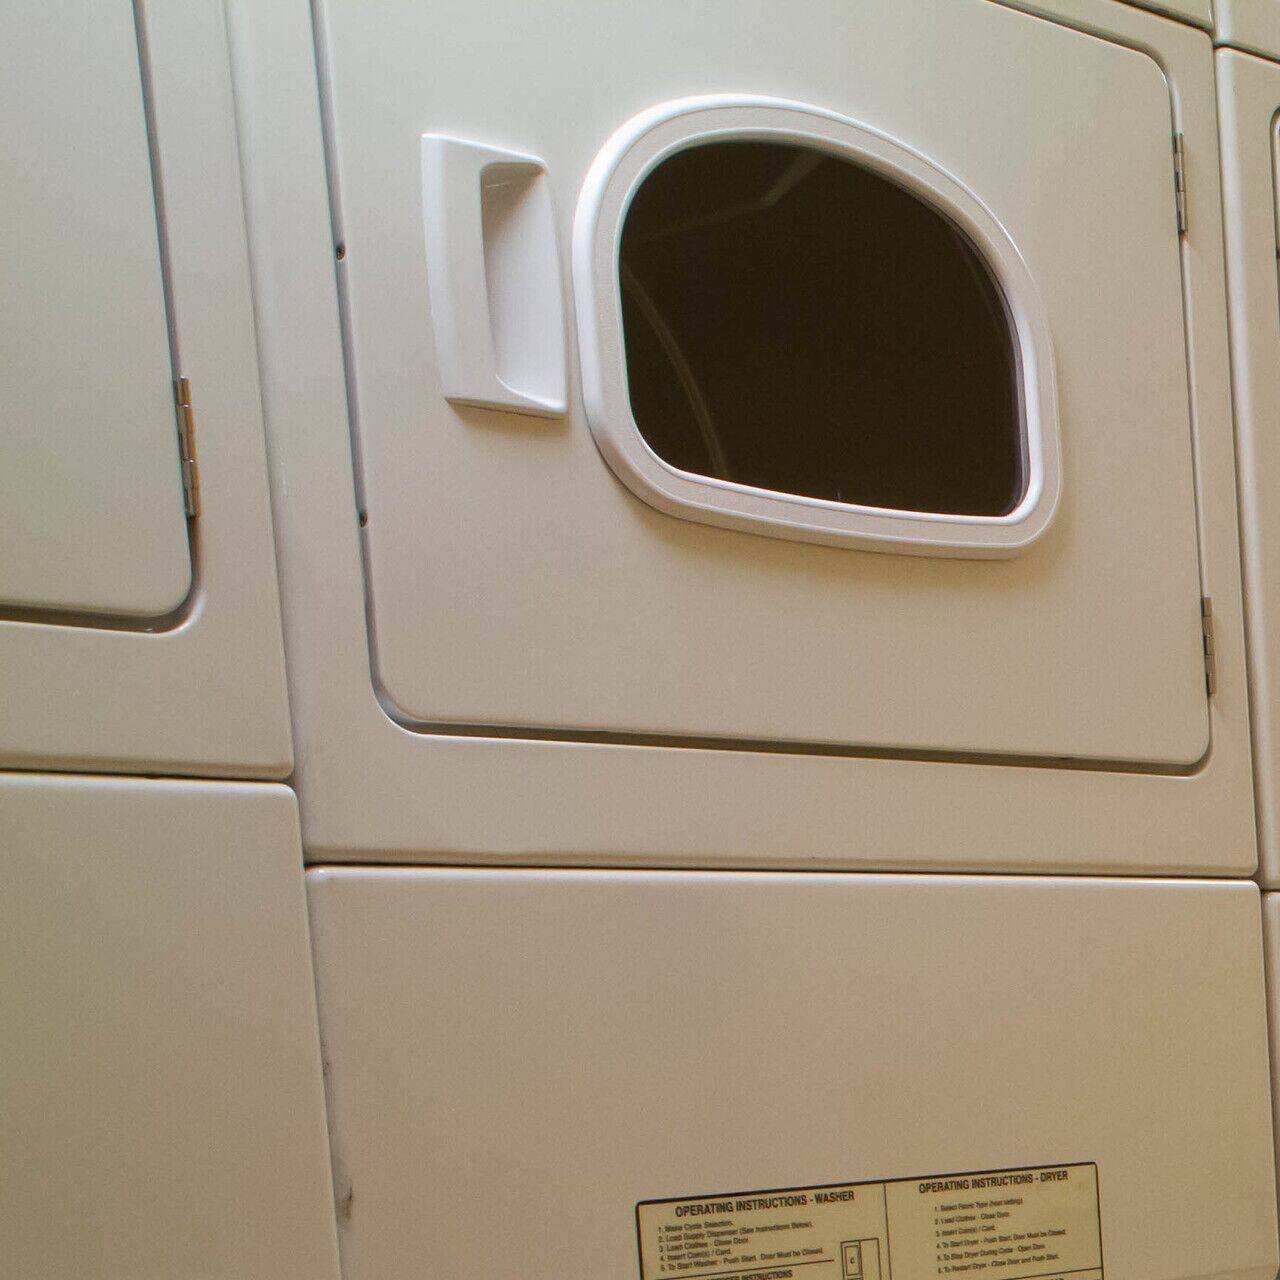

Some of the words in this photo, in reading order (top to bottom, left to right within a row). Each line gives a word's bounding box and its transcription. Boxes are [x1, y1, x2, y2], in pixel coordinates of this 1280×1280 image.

[919, 1179, 969, 1194] OPERATING
[971, 1173, 1033, 1189] INSTRUCTIONS
[1040, 1170, 1068, 1183] DRYER
[675, 1201, 733, 1217] OPERATING
[736, 1194, 807, 1212] INSTRUCTIONS
[814, 1190, 855, 1204] WASHER
